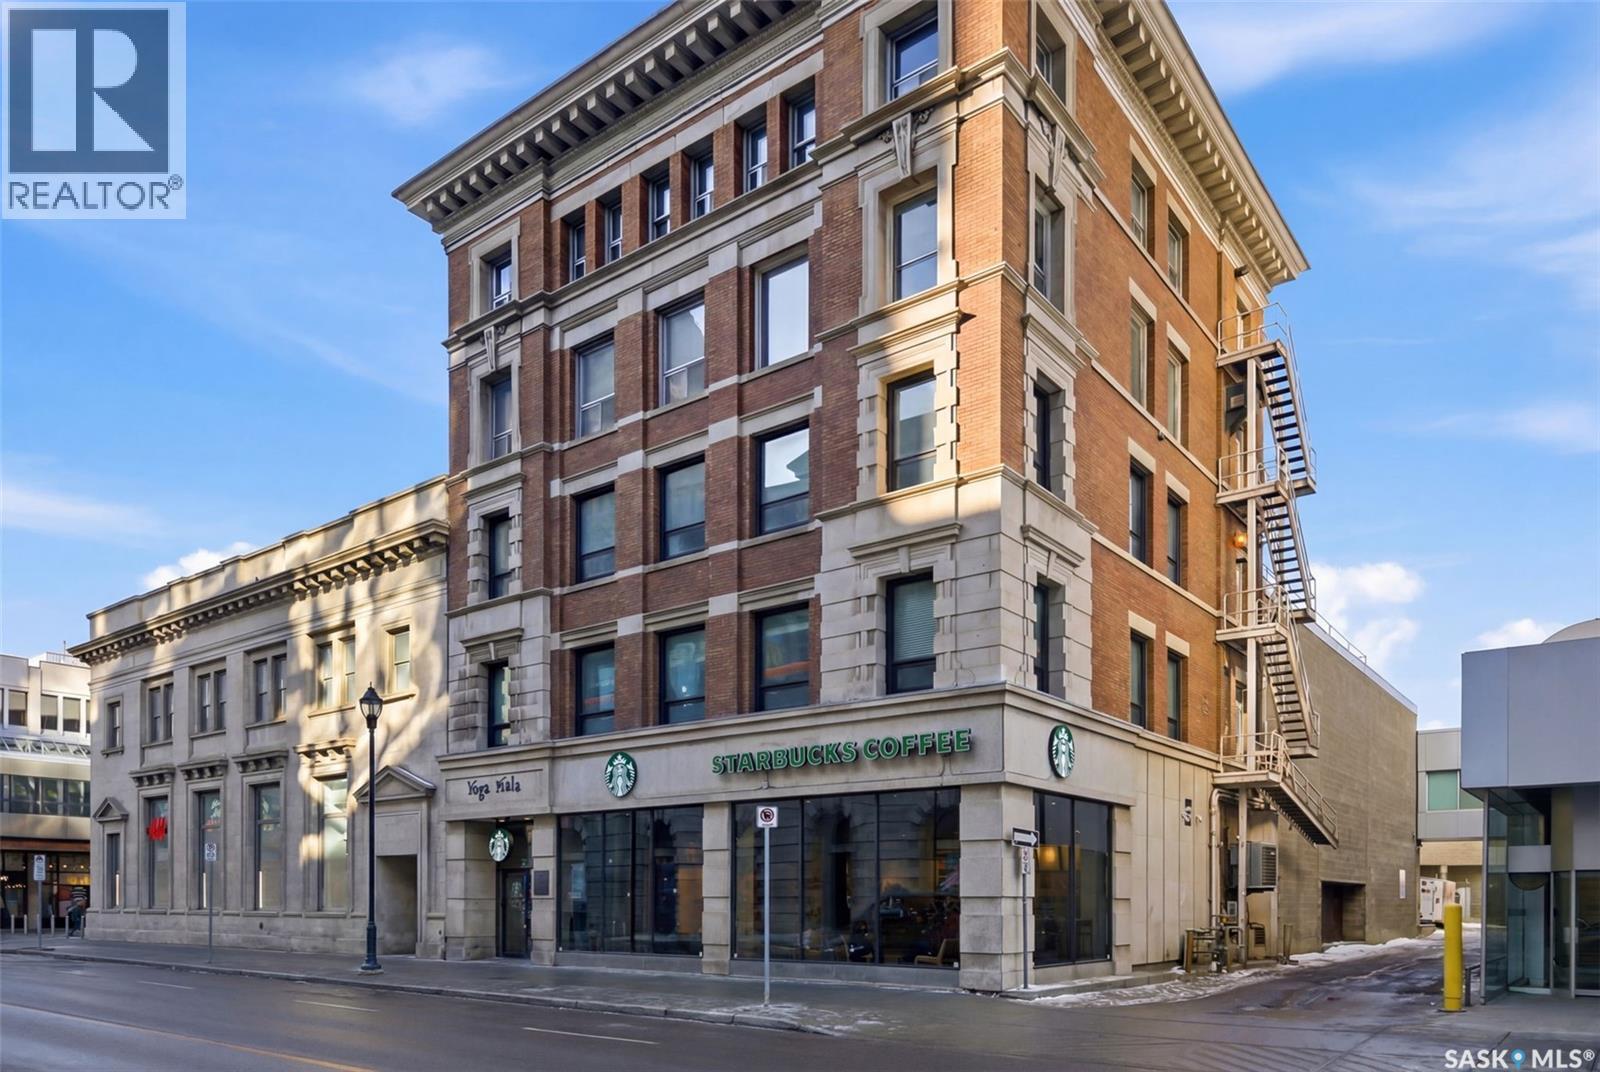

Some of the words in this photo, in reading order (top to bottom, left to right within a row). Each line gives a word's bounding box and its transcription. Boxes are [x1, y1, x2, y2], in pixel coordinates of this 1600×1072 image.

[711, 742, 858, 775] STARBUCKS
[863, 728, 972, 761] COFFEE
[467, 780, 491, 801] Yoga
